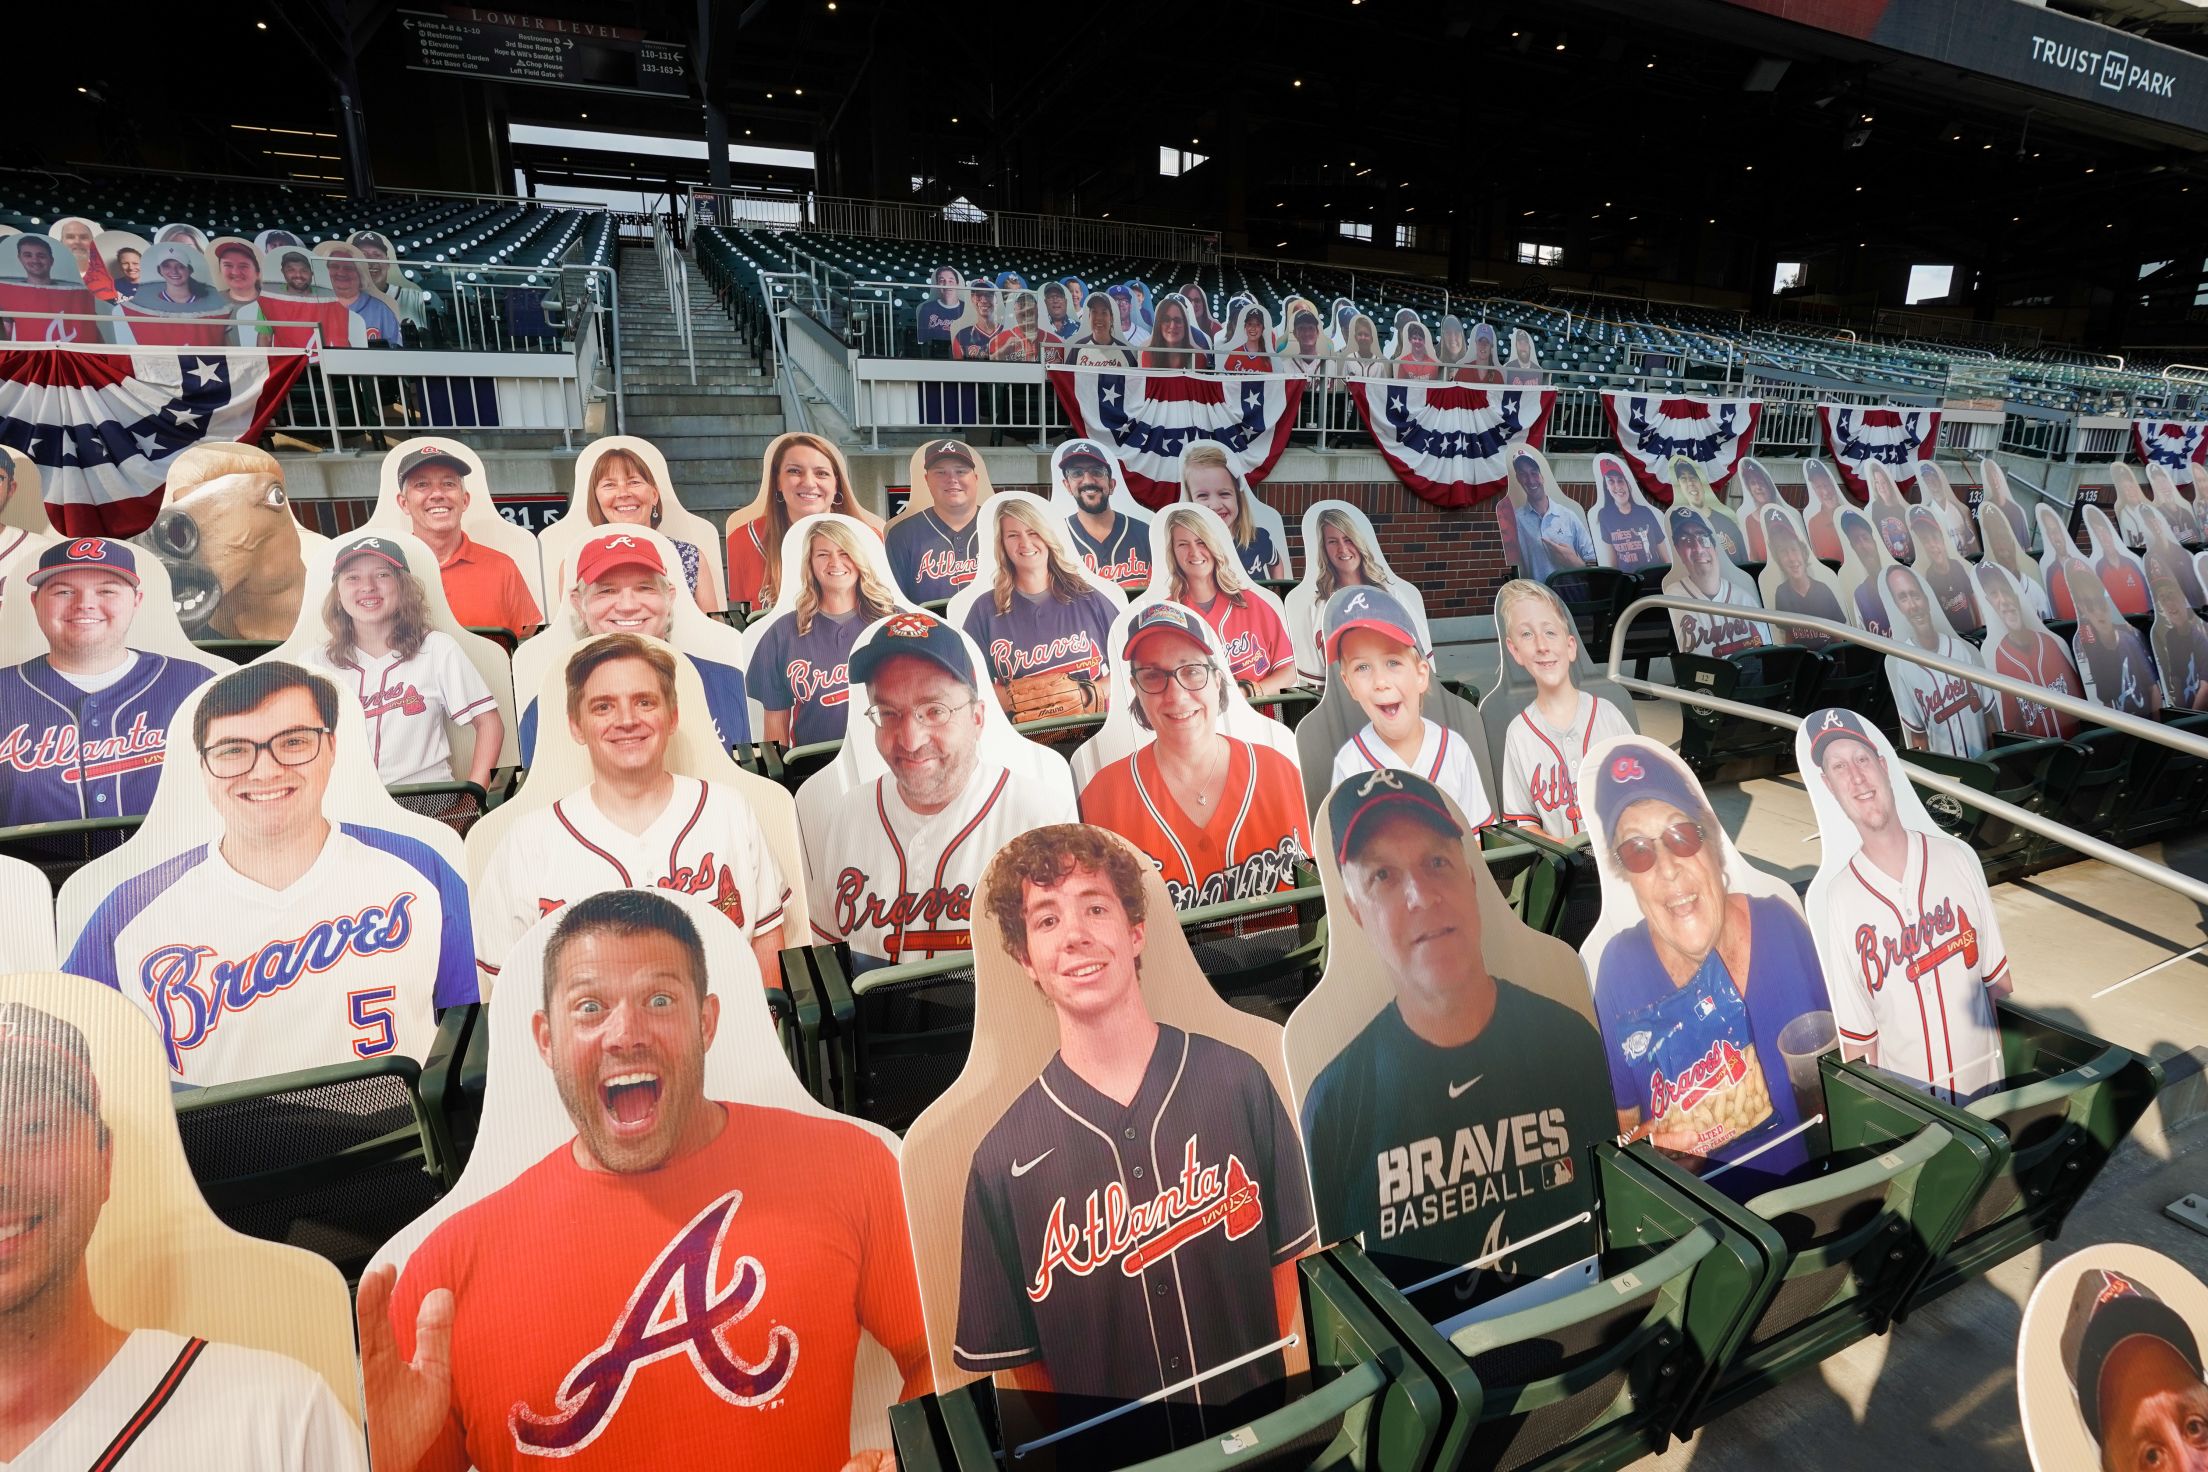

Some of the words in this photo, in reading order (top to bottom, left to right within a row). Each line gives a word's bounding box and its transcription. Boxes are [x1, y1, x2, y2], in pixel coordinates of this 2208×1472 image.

[471, 8, 545, 29] LOWER
[558, 20, 622, 39] LEVEL
[427, 31, 463, 41] Restrooms
[428, 40, 460, 50] Elevators
[518, 33, 552, 44] Restrooms
[430, 49, 465, 60] Monument
[466, 53, 490, 63] Garden
[525, 60, 543, 69] Chop
[543, 61, 564, 71] House
[641, 50, 672, 61] 110-131
[642, 63, 674, 75] 133-163
[2032, 36, 2102, 76] TRUIST
[2127, 65, 2177, 98] PARK
[938, 441, 956, 452] A
[1073, 443, 1089, 453] A
[1968, 490, 1984, 503] 133
[2085, 490, 2098, 502] 135
[353, 536, 380, 550] A
[606, 535, 636, 549] A
[1343, 592, 1369, 614] A
[991, 630, 1089, 681] Braves
[1821, 709, 1844, 731] A
[0, 711, 167, 773] Atlanta
[1357, 768, 1403, 797] A
[835, 866, 976, 936] Brave
[1855, 896, 1955, 998] Braves
[138, 891, 417, 1076] Braves
[347, 985, 398, 1060] 5
[1651, 1039, 1723, 1121] Braves
[1697, 1124, 1723, 1143] ALTED
[1377, 1107, 1570, 1207] BRAVES
[1380, 1169, 1535, 1240] BASEBALL
[1026, 1133, 1223, 1303] Atlanta
[507, 1189, 800, 1458] A
